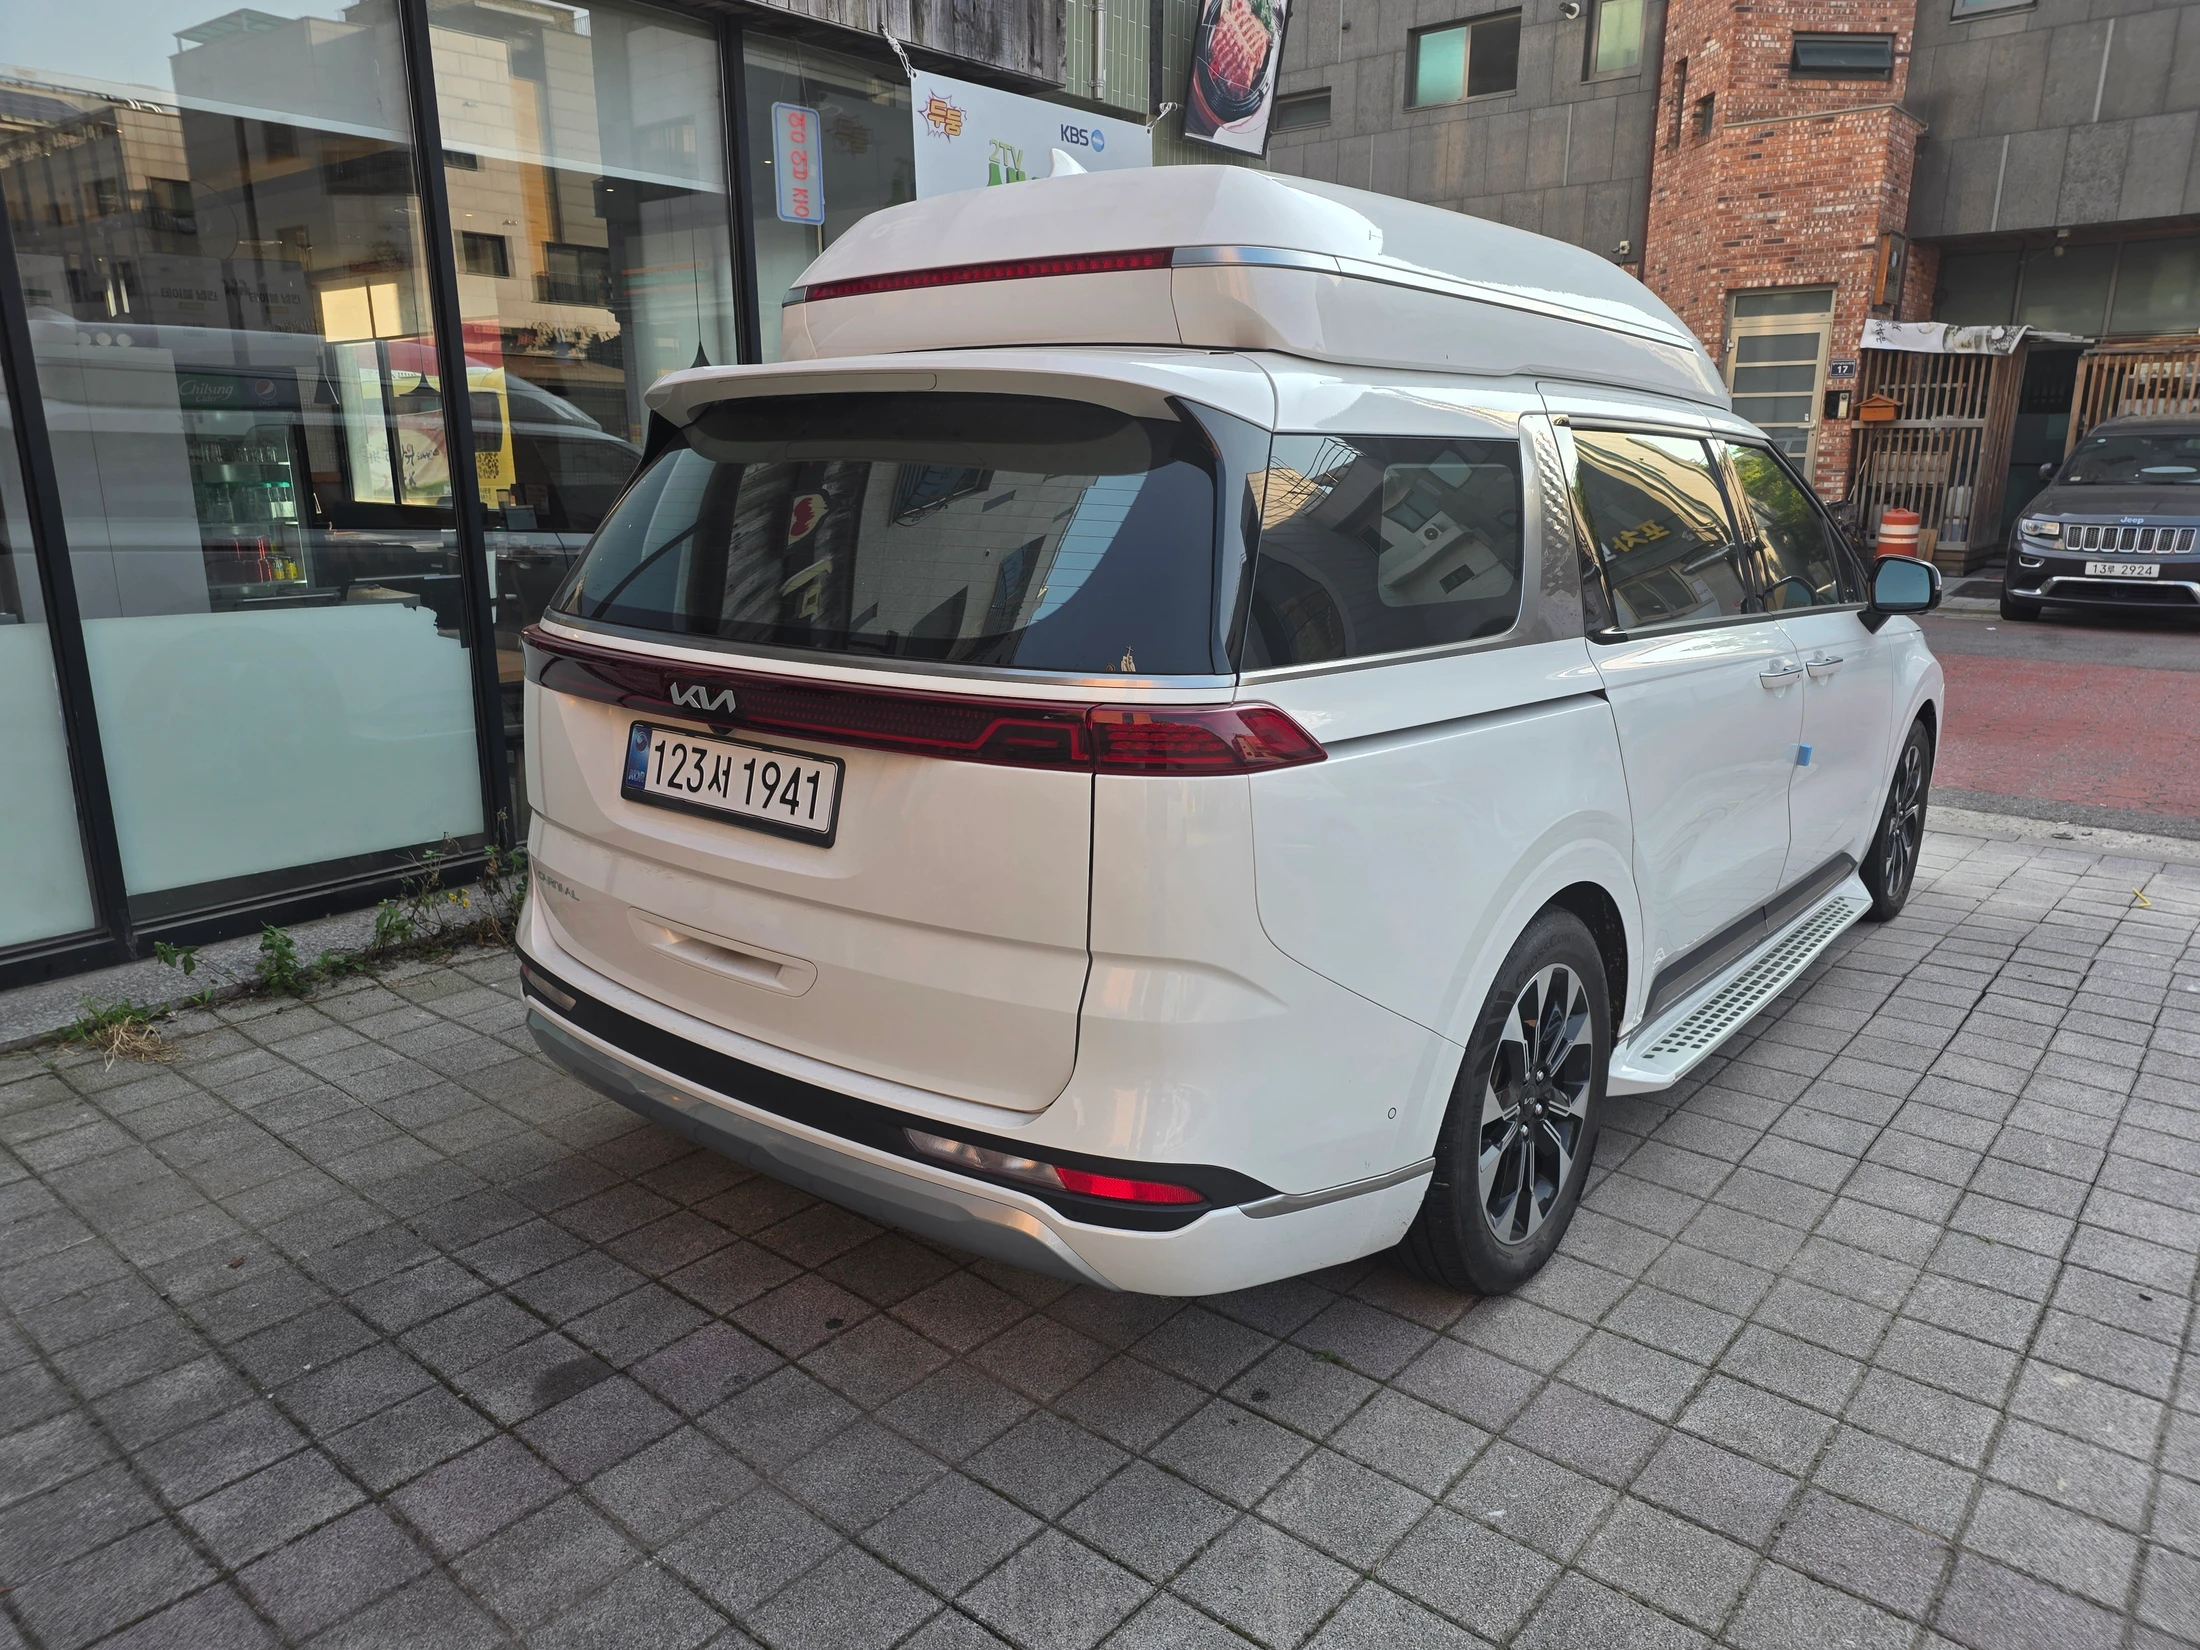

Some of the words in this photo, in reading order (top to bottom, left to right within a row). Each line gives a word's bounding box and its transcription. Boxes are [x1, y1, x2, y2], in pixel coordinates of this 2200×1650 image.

[927, 97, 963, 137] 두둥
[1060, 123, 1089, 147] KBS
[788, 111, 810, 218] 영업중
[988, 138, 1024, 170] 2TV
[1837, 365, 1849, 374] 17
[2120, 516, 2144, 525] Jeep
[2093, 564, 2115, 575] 13루
[2121, 565, 2152, 576] 2924
[669, 681, 737, 713] KIA
[627, 768, 646, 784] KOR
[654, 740, 733, 799] 123서
[743, 757, 821, 820] 1941
